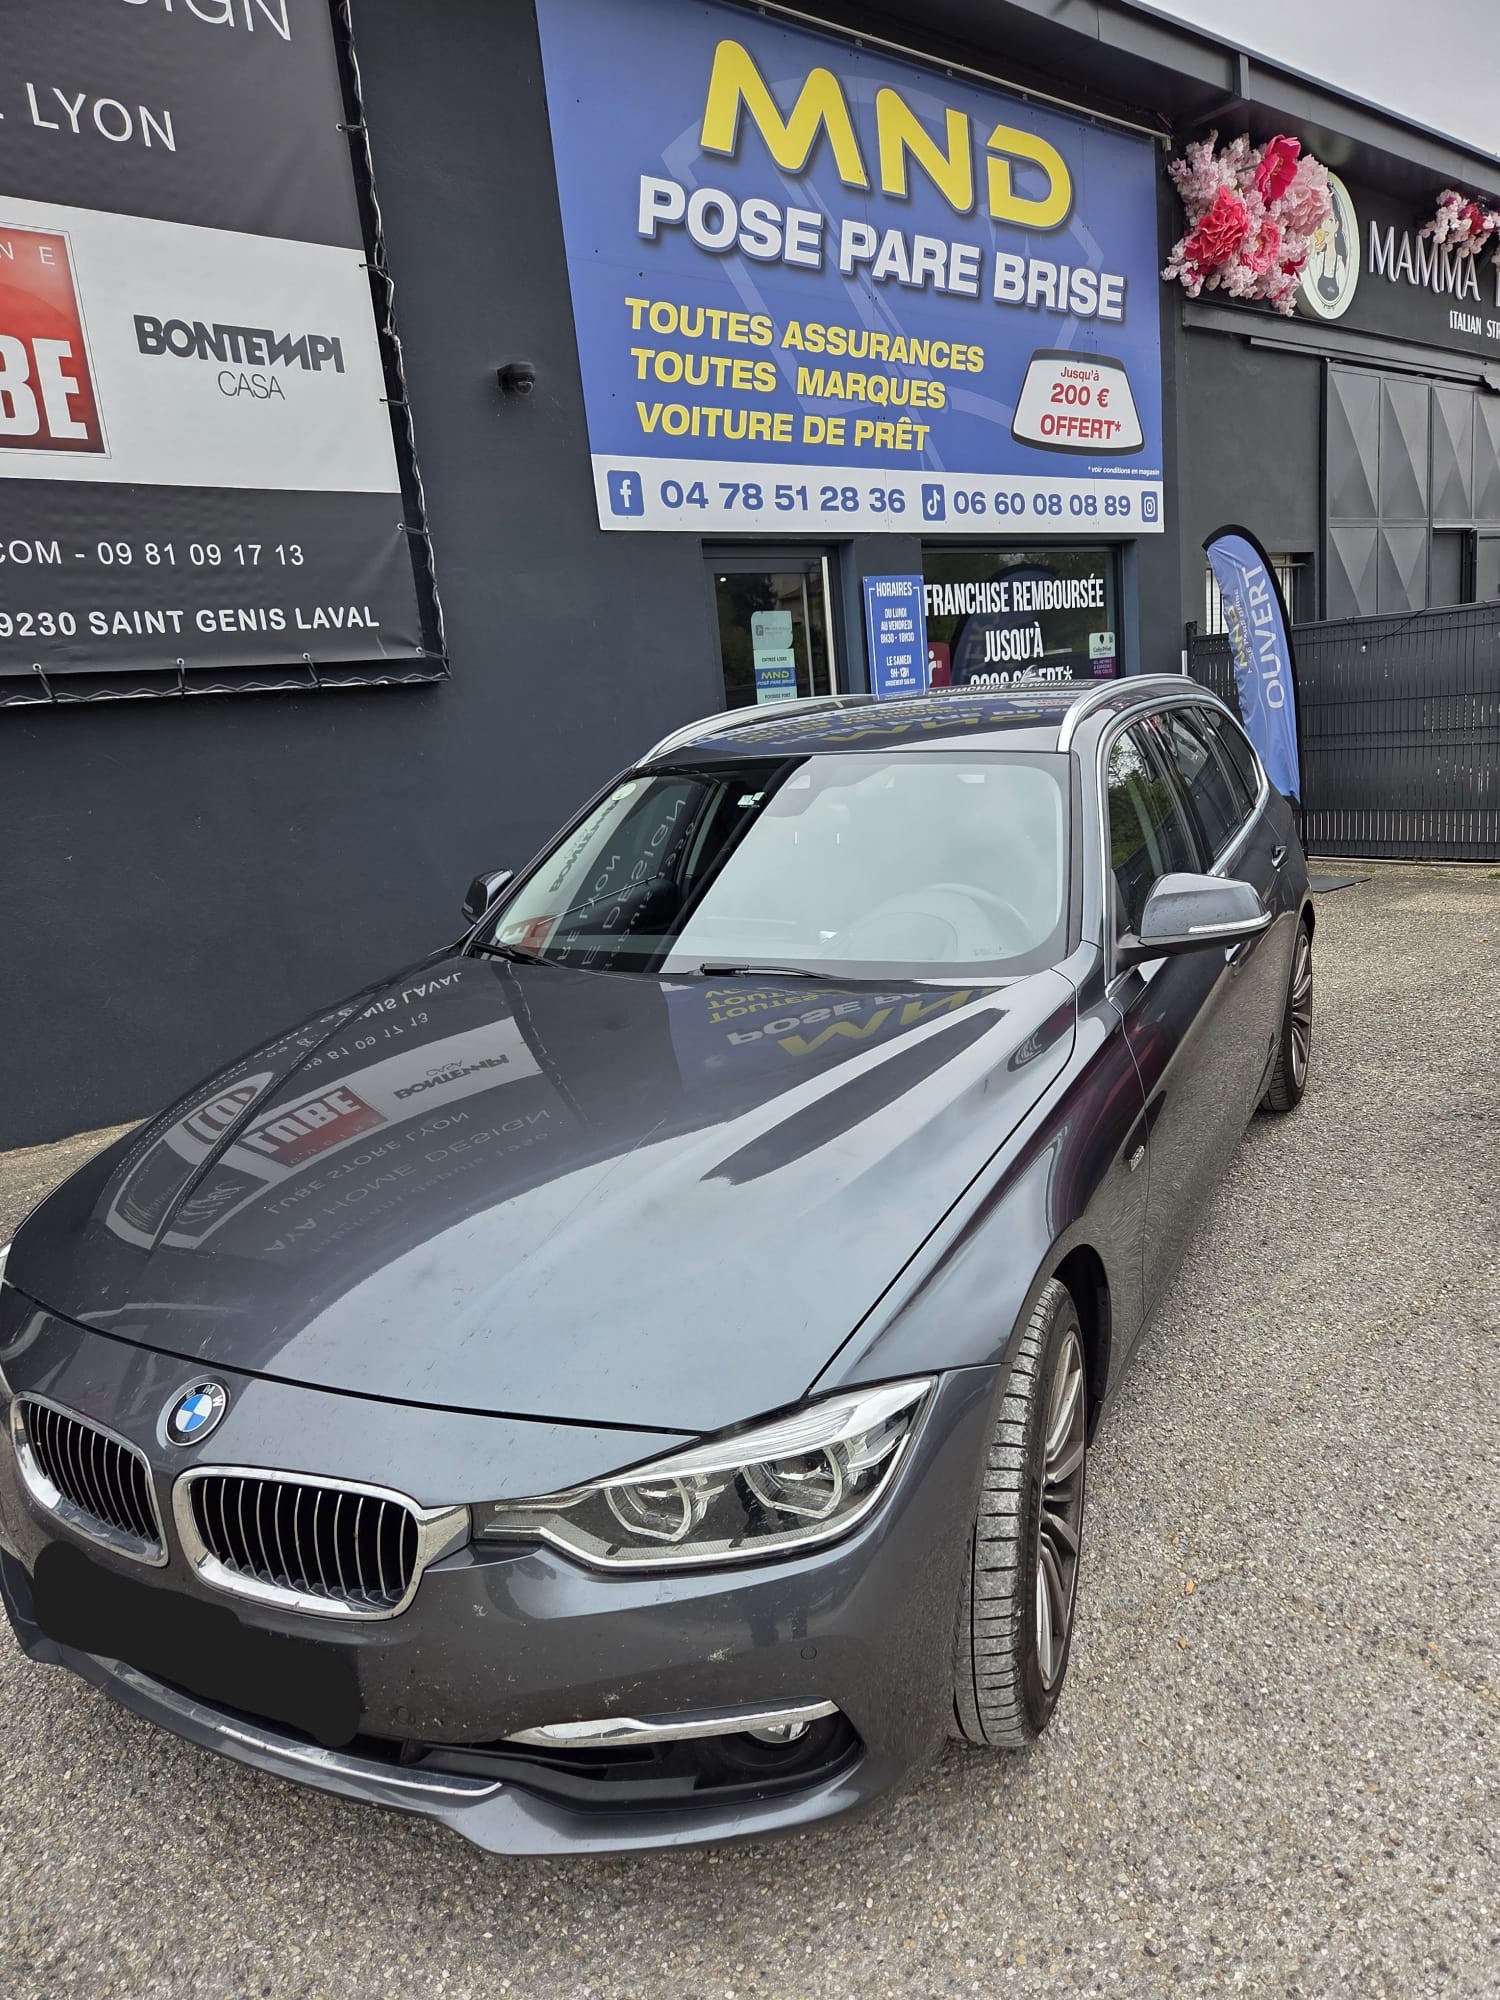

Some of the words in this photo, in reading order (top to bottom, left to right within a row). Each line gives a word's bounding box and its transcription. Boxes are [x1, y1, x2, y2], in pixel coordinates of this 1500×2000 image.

[26, 82, 176, 152] LYON
[700, 39, 1073, 229] MND
[638, 174, 823, 267] POSE
[839, 218, 981, 295] PARE
[993, 251, 1126, 320] BRISE
[1369, 220, 1481, 301] MAMMA
[625, 297, 773, 347] TOUTES
[781, 320, 985, 373] ASSURANCES
[1449, 309, 1482, 336] ITALIAN
[133, 314, 345, 374] BONTEMPI
[217, 370, 286, 400] CASA
[630, 347, 777, 393] TOUTES
[796, 366, 946, 410] MARQUES
[1060, 366, 1100, 383] Jusqu'à
[1050, 382, 1091, 406] 200
[1096, 387, 1110, 408] €
[635, 401, 793, 443] VOITURE
[802, 415, 846, 446] DE
[853, 416, 931, 452] PRÊT
[660, 479, 709, 509] 04
[718, 482, 764, 511] 78
[774, 484, 809, 512] 51
[819, 485, 860, 513] 28
[868, 487, 906, 515] 36
[953, 490, 986, 516] 06
[993, 491, 1026, 516] 60
[1032, 492, 1063, 517] 08
[1069, 493, 1098, 517] 08
[1104, 494, 1131, 517] 89
[98, 542, 132, 565] 09
[145, 543, 175, 565] 81
[189, 544, 222, 565] 09
[235, 544, 261, 565] 17
[275, 545, 304, 565] 13
[876, 581, 913, 597] HORAIRES
[923, 581, 1010, 617] FRANCHISE
[1013, 573, 1105, 612] REMBOURSÉE
[89, 610, 184, 635] SAINT
[196, 607, 286, 633] GENIS
[296, 606, 380, 631] LAVAL
[1242, 564, 1285, 709] OUVERT
[984, 621, 1044, 663] JUSQU'À
[761, 670, 790, 680] MND
[186, 1384, 223, 1407] BMW
